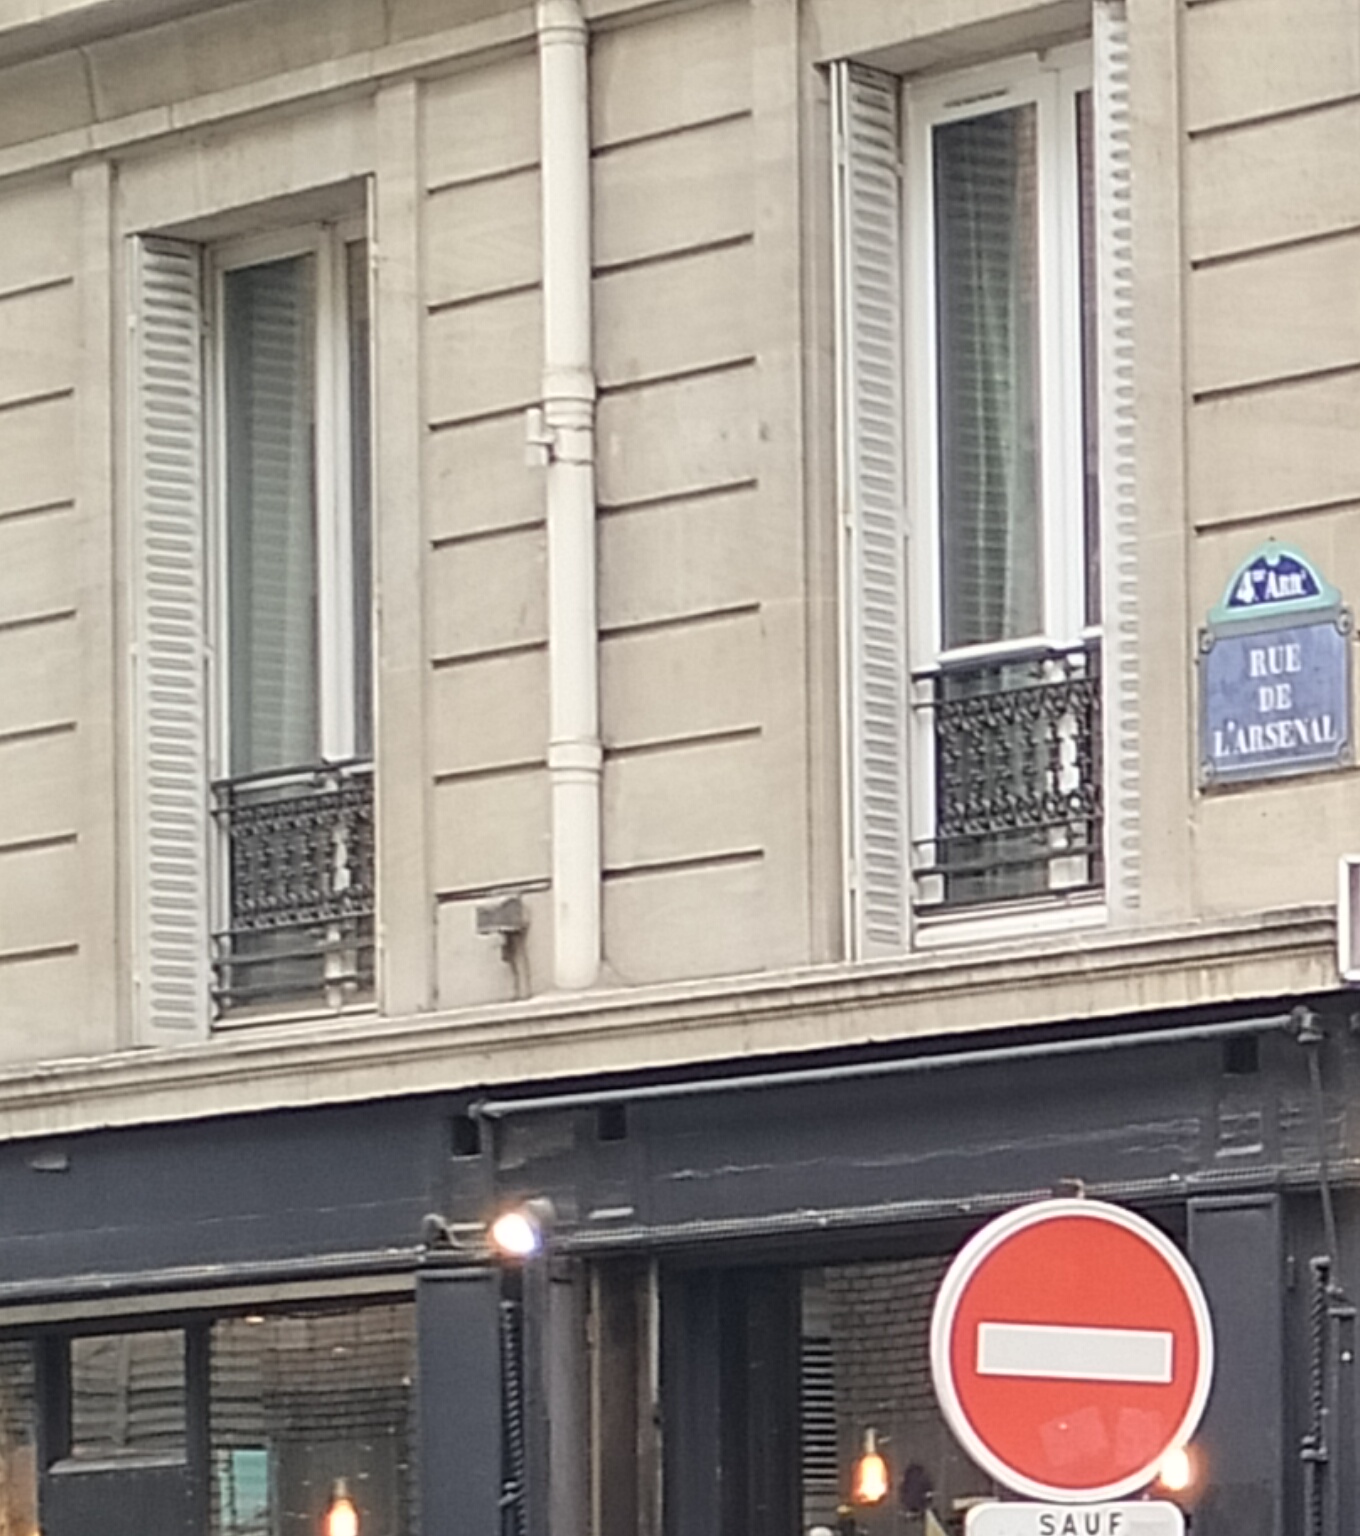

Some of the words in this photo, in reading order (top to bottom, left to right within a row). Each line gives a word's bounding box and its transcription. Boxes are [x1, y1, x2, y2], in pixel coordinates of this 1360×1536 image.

[1250, 643, 1301, 677] RUE
[1258, 683, 1292, 712] DE
[1213, 715, 1337, 757] L'ARSENAL
[1040, 1512, 1123, 1536] SAUF
